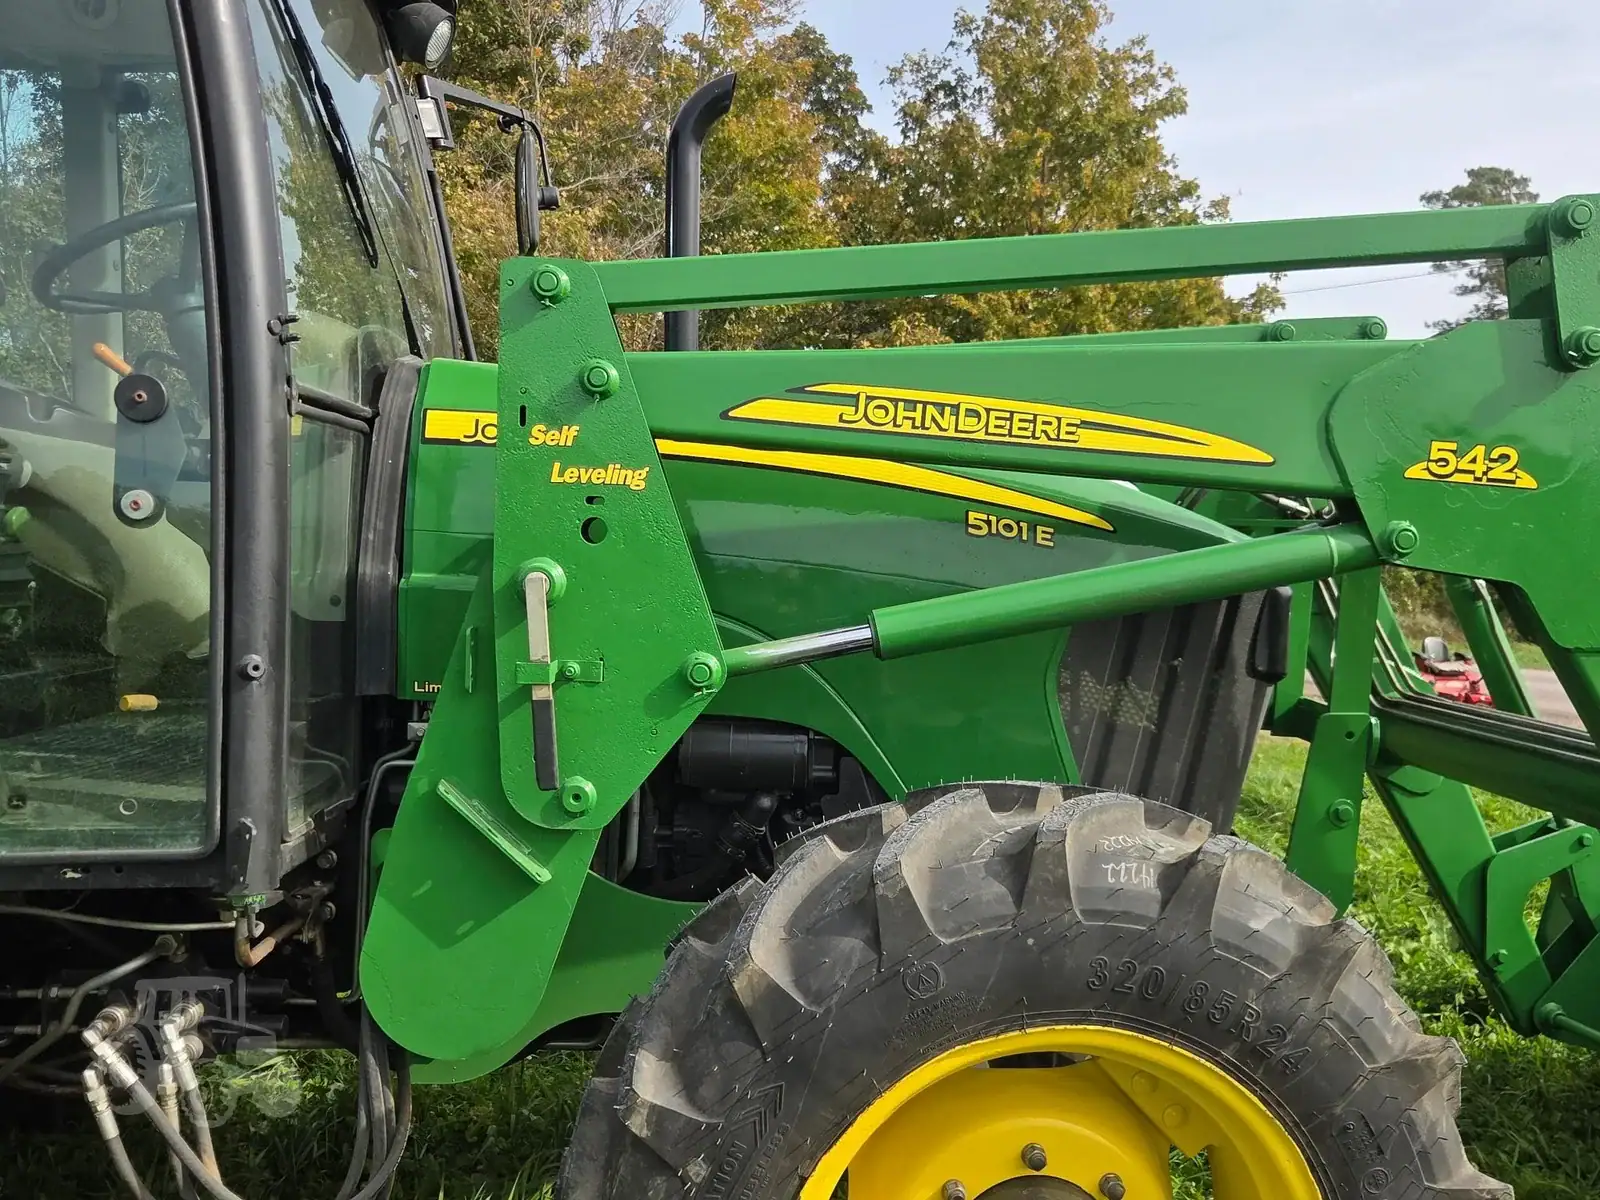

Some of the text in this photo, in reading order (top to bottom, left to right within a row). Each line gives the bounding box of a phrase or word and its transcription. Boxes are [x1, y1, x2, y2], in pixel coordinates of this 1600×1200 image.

[528, 423, 580, 447] Self
[550, 461, 649, 491] Leveling
[1427, 440, 1519, 484] 542
[1087, 955, 1313, 1075] 320/85R24
